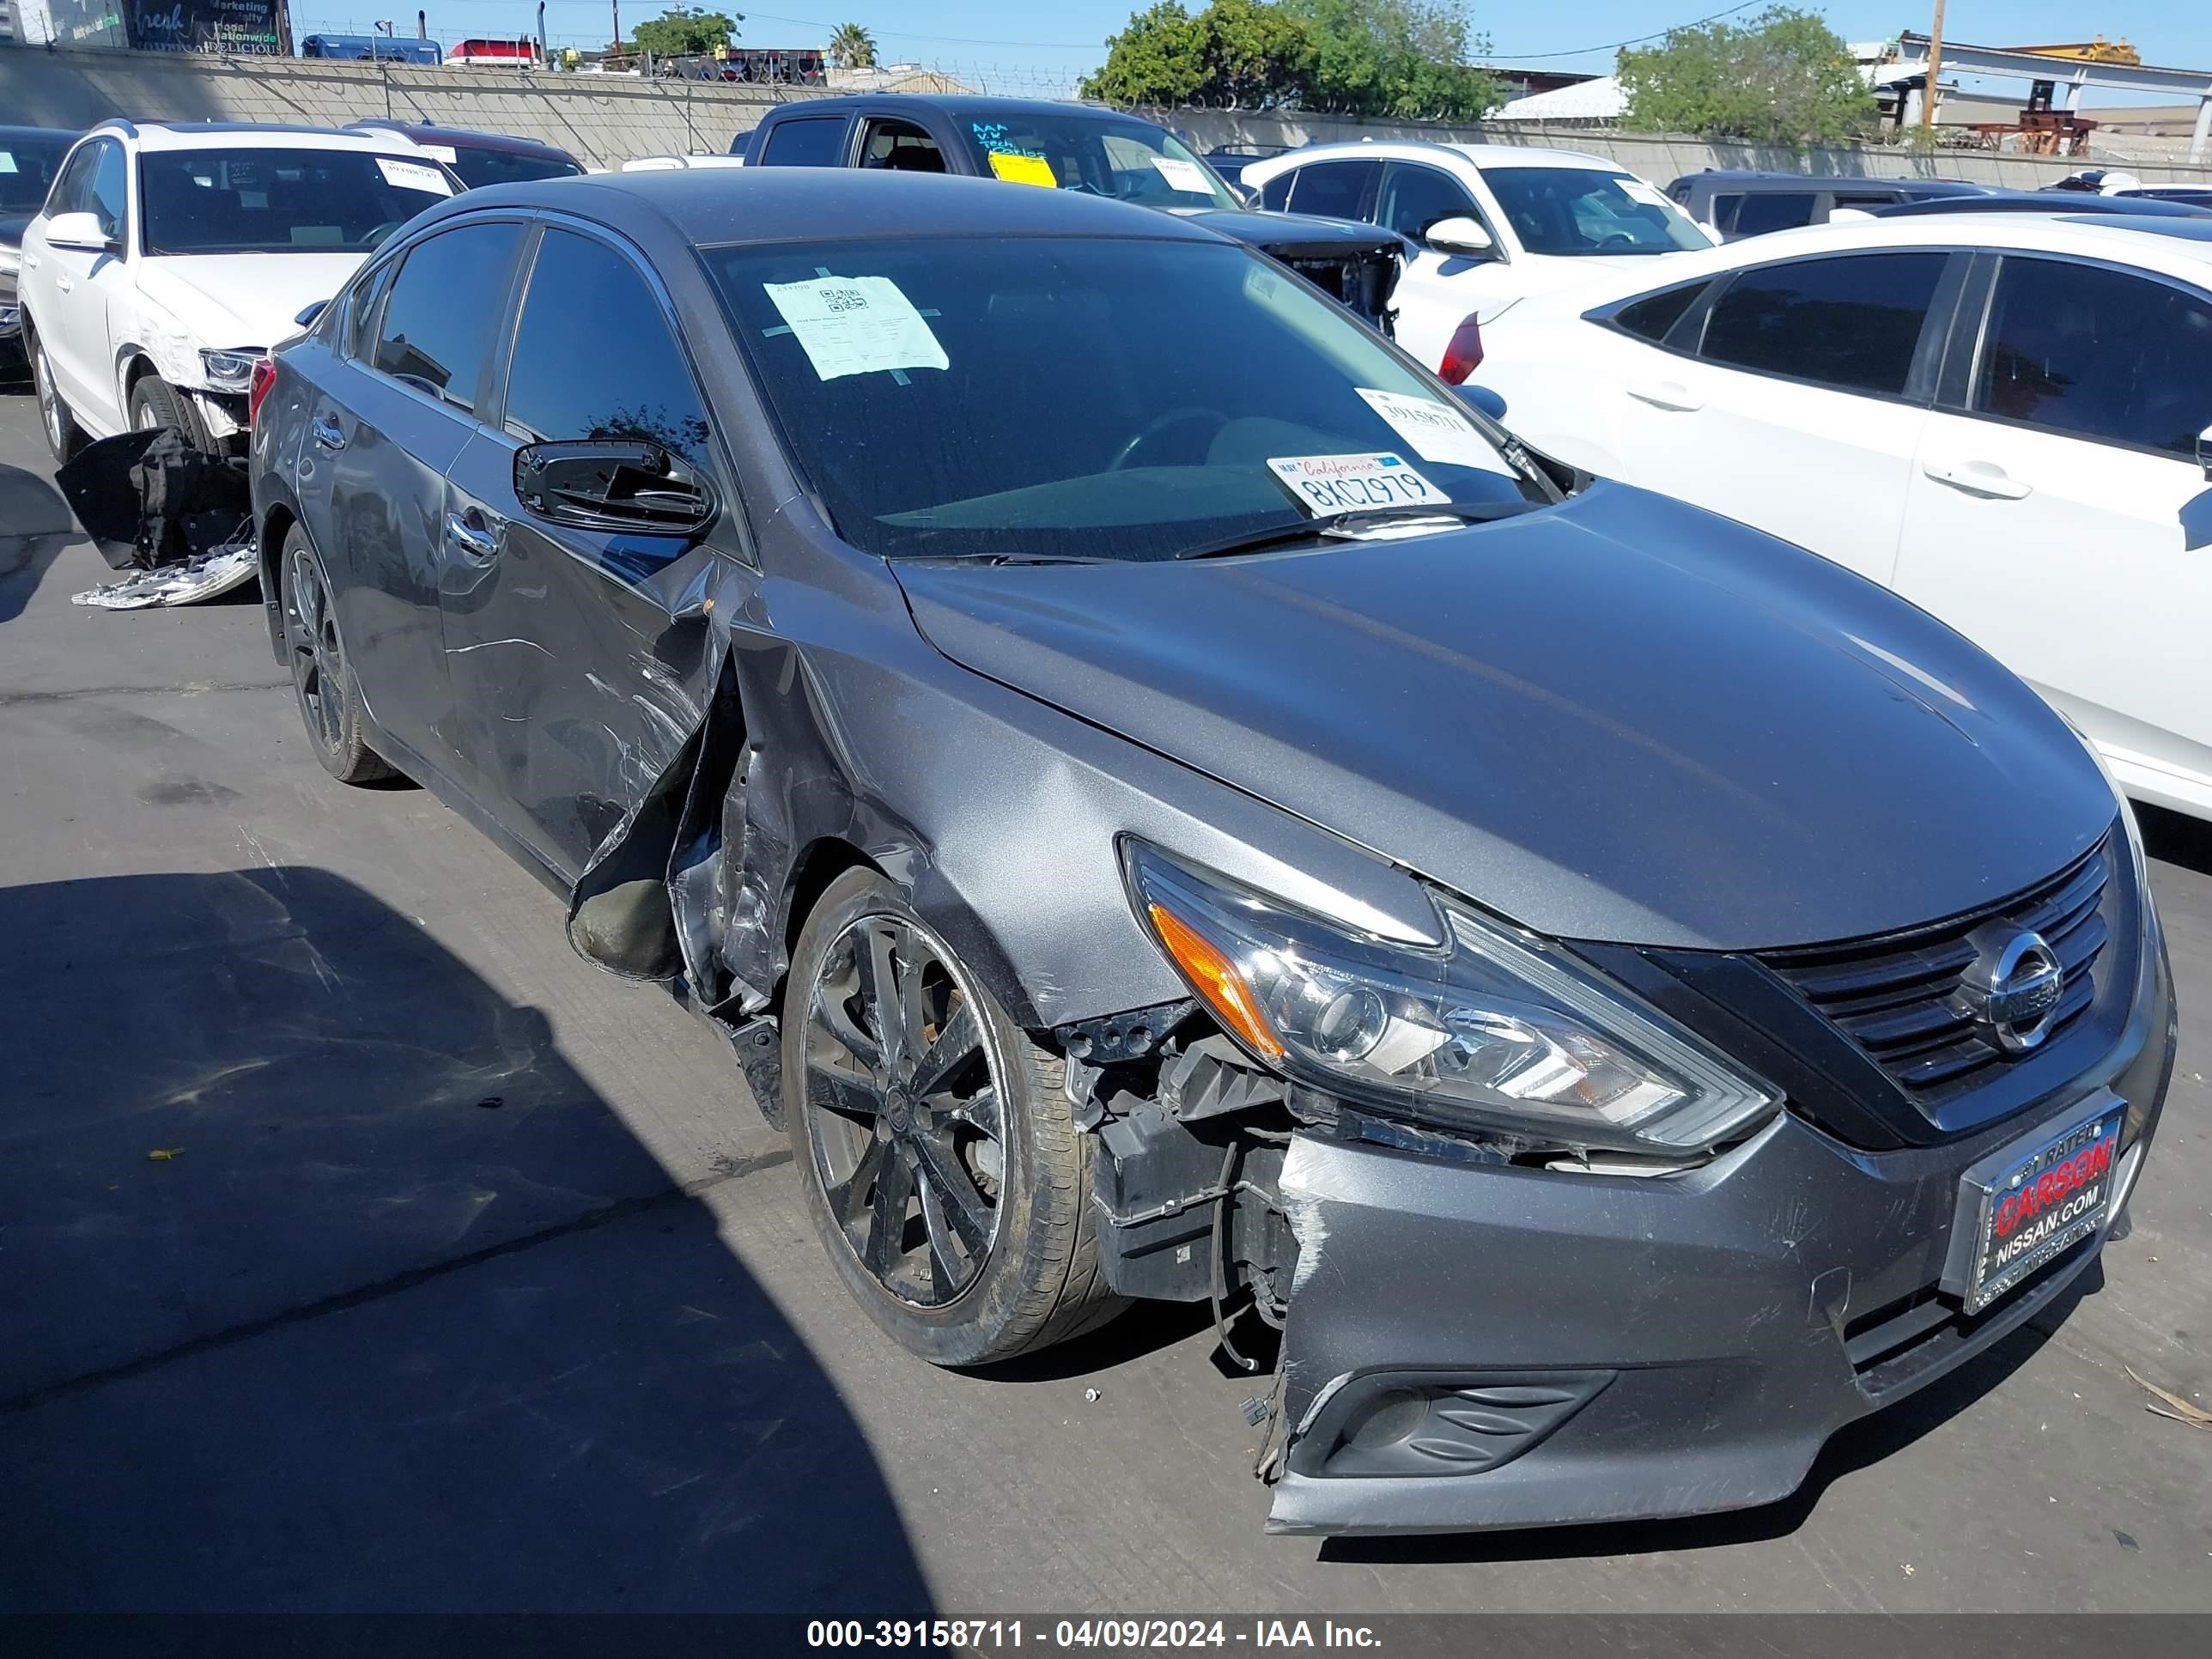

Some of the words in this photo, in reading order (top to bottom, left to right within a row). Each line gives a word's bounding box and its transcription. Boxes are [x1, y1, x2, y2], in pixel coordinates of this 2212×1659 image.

[1382, 404, 1467, 432] 39158711
[1278, 465, 1298, 473] MAY
[1304, 460, 1381, 478] California
[1301, 473, 1427, 507] 8XCZ979
[2045, 1124, 2095, 1164] RATED
[1996, 1135, 2114, 1237] CARSON
[1996, 1185, 2099, 1269] NISSAN.COM
